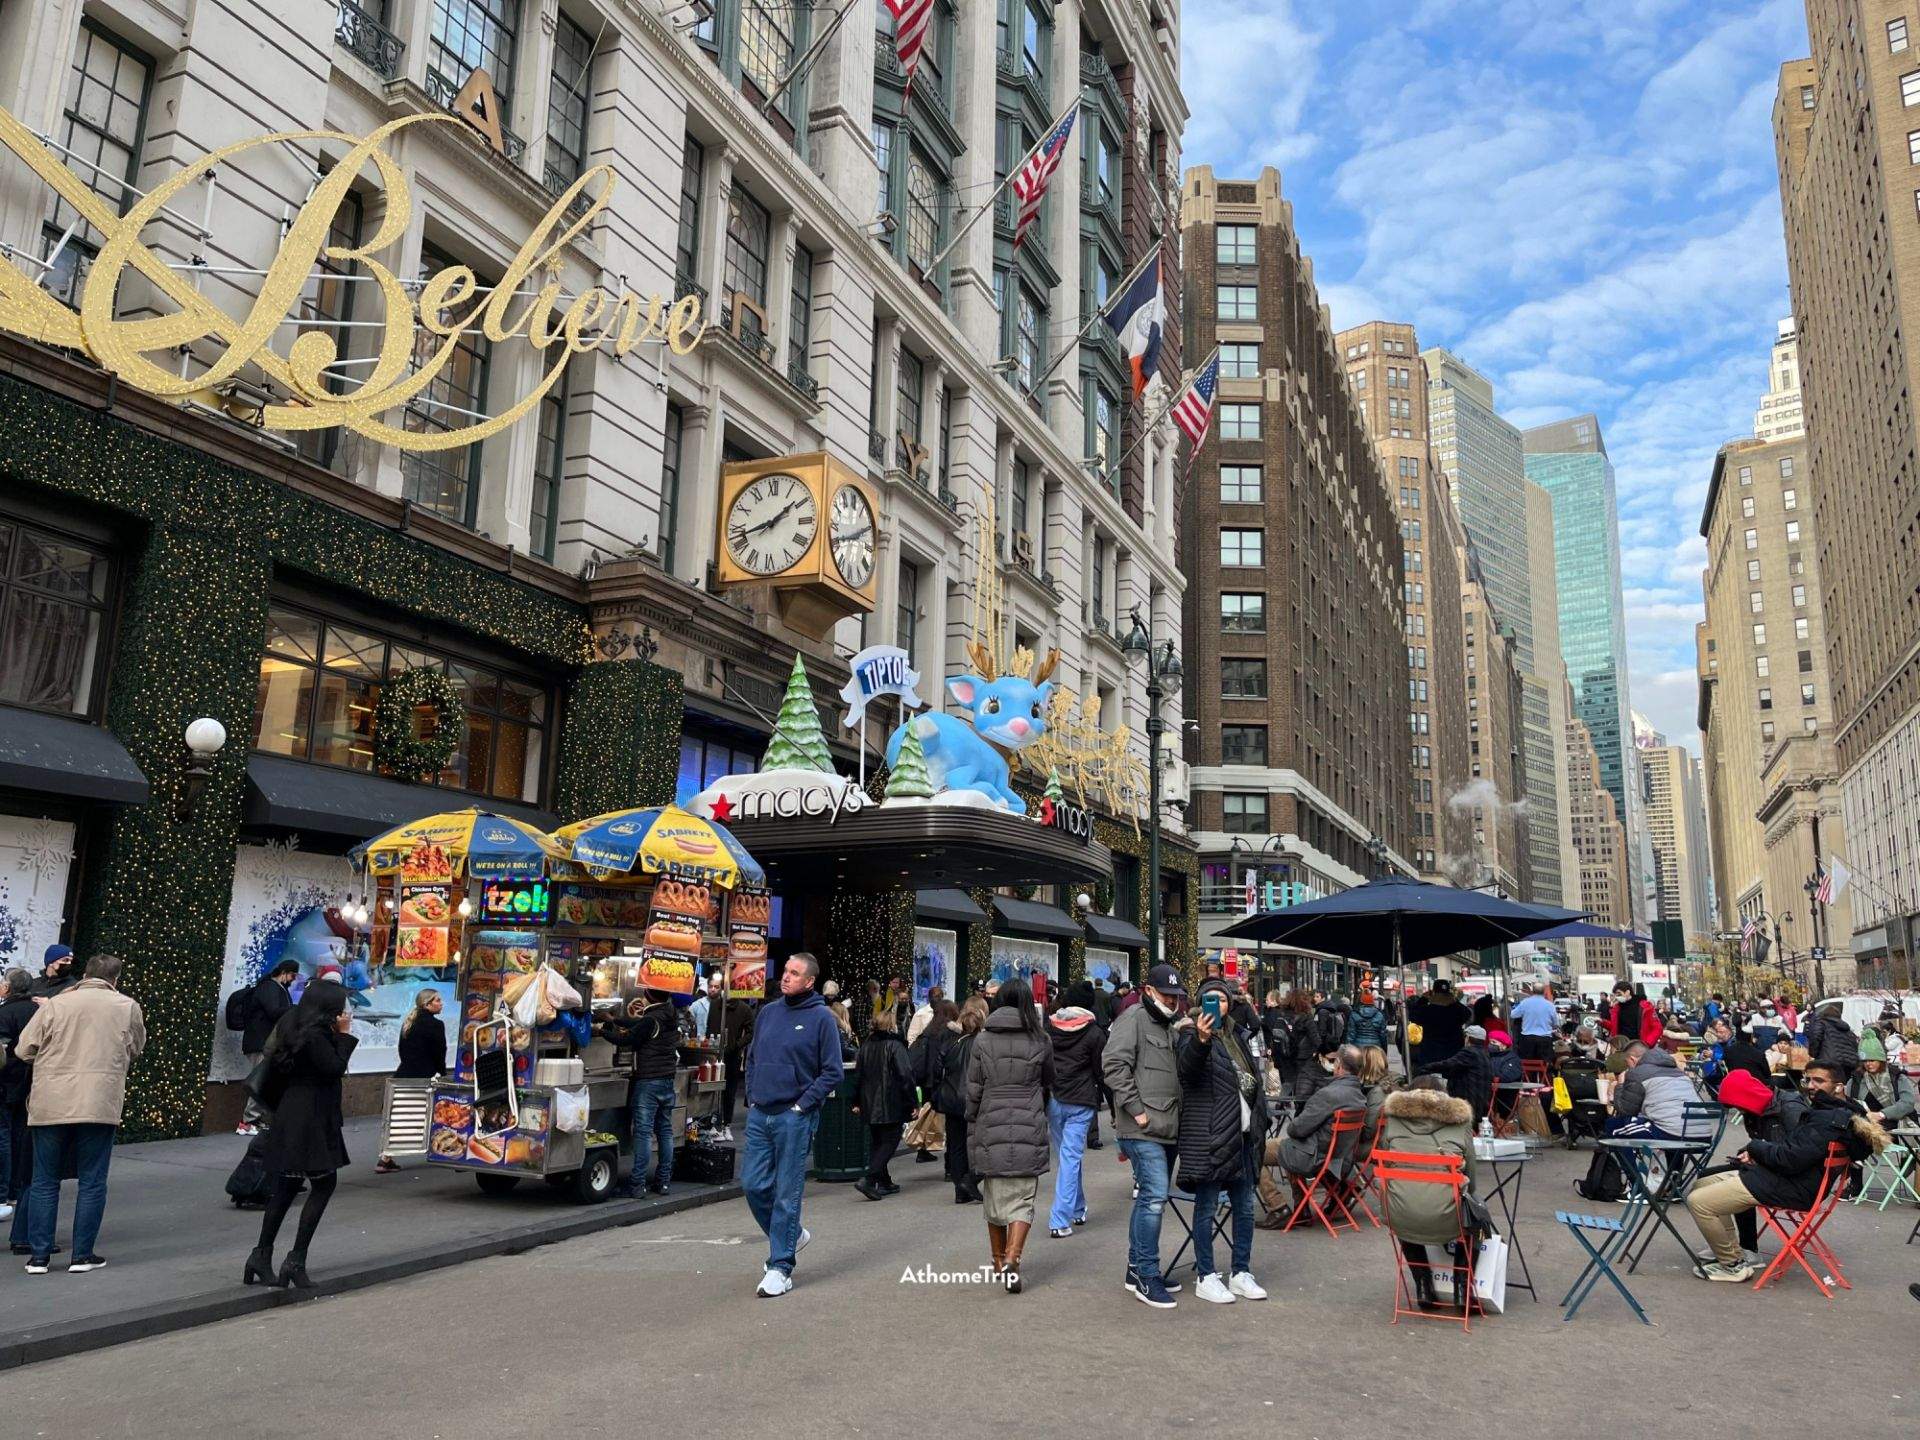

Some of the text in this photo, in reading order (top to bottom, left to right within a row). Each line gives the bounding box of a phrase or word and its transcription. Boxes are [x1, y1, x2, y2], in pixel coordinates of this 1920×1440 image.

[80, 112, 706, 450] Believe
[452, 66, 506, 156] A
[899, 431, 930, 480] Y
[861, 656, 911, 693] TIPTOE
[738, 775, 863, 825] macy's
[657, 829, 712, 838] SABRETT
[1641, 970, 1667, 978] FedEx
